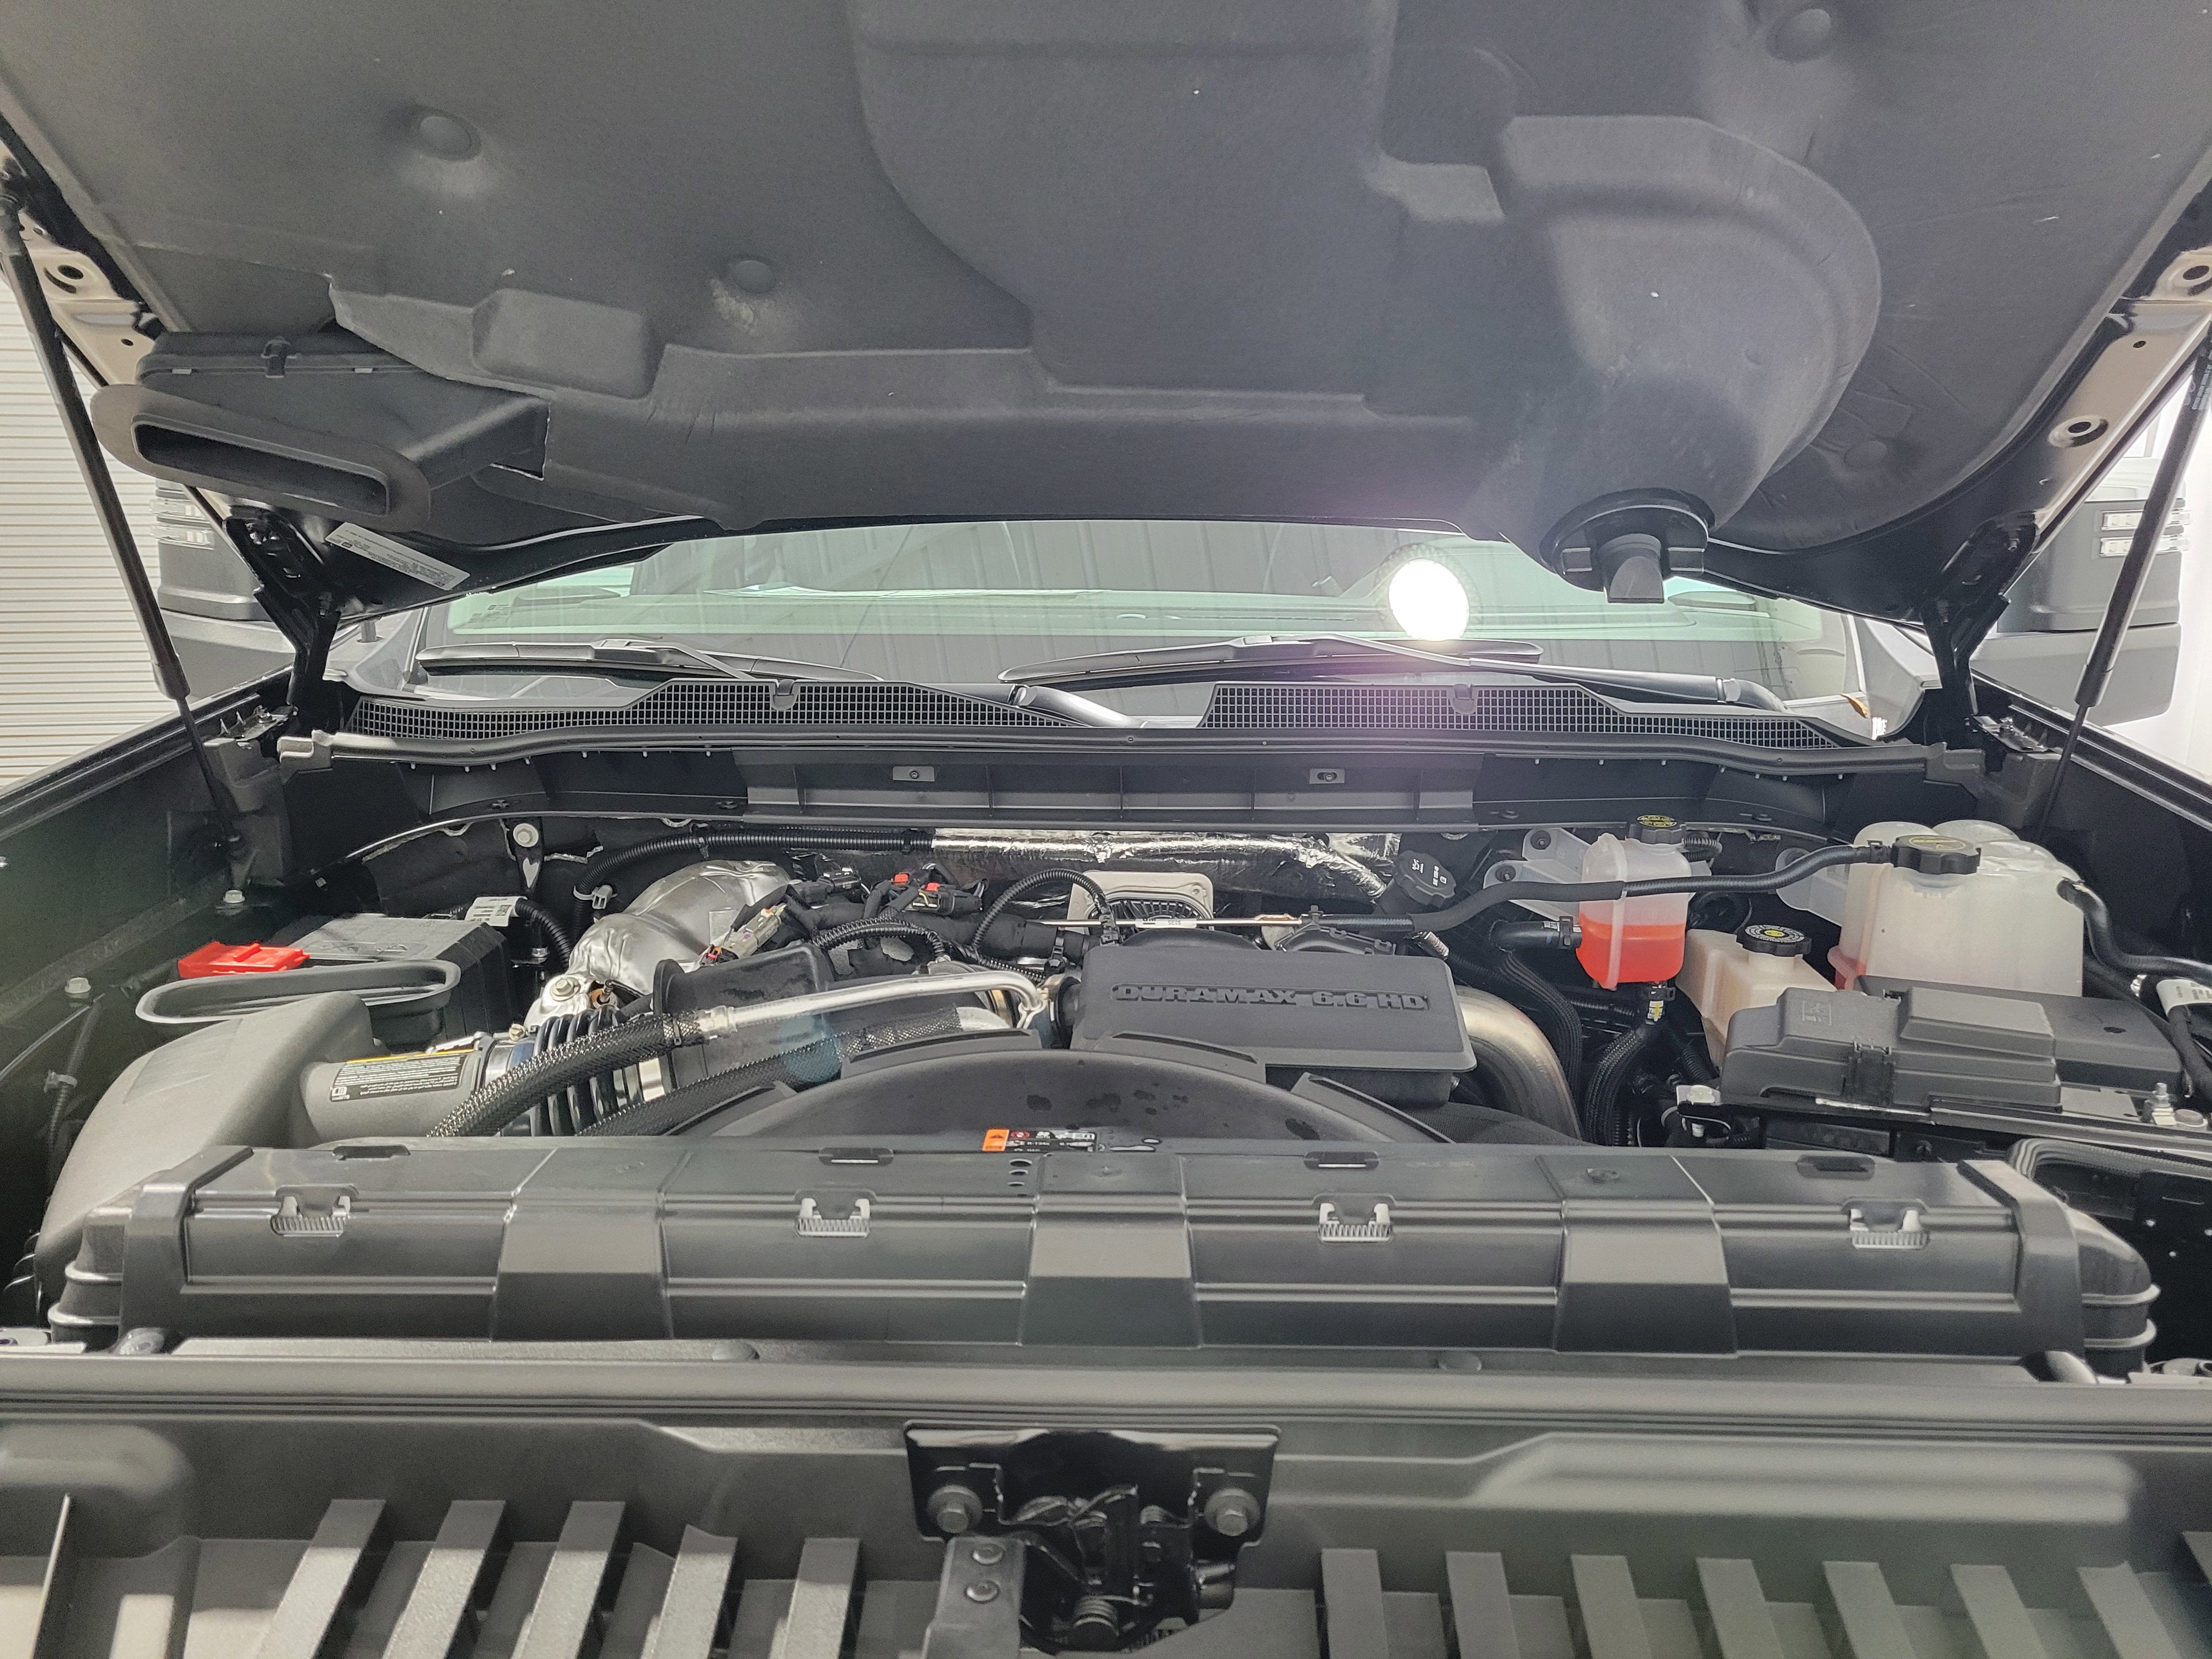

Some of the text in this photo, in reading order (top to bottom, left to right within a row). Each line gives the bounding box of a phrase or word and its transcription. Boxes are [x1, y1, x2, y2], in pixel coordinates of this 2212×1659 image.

[1116, 986, 1427, 1011] DURAMAX 6.6 HD
